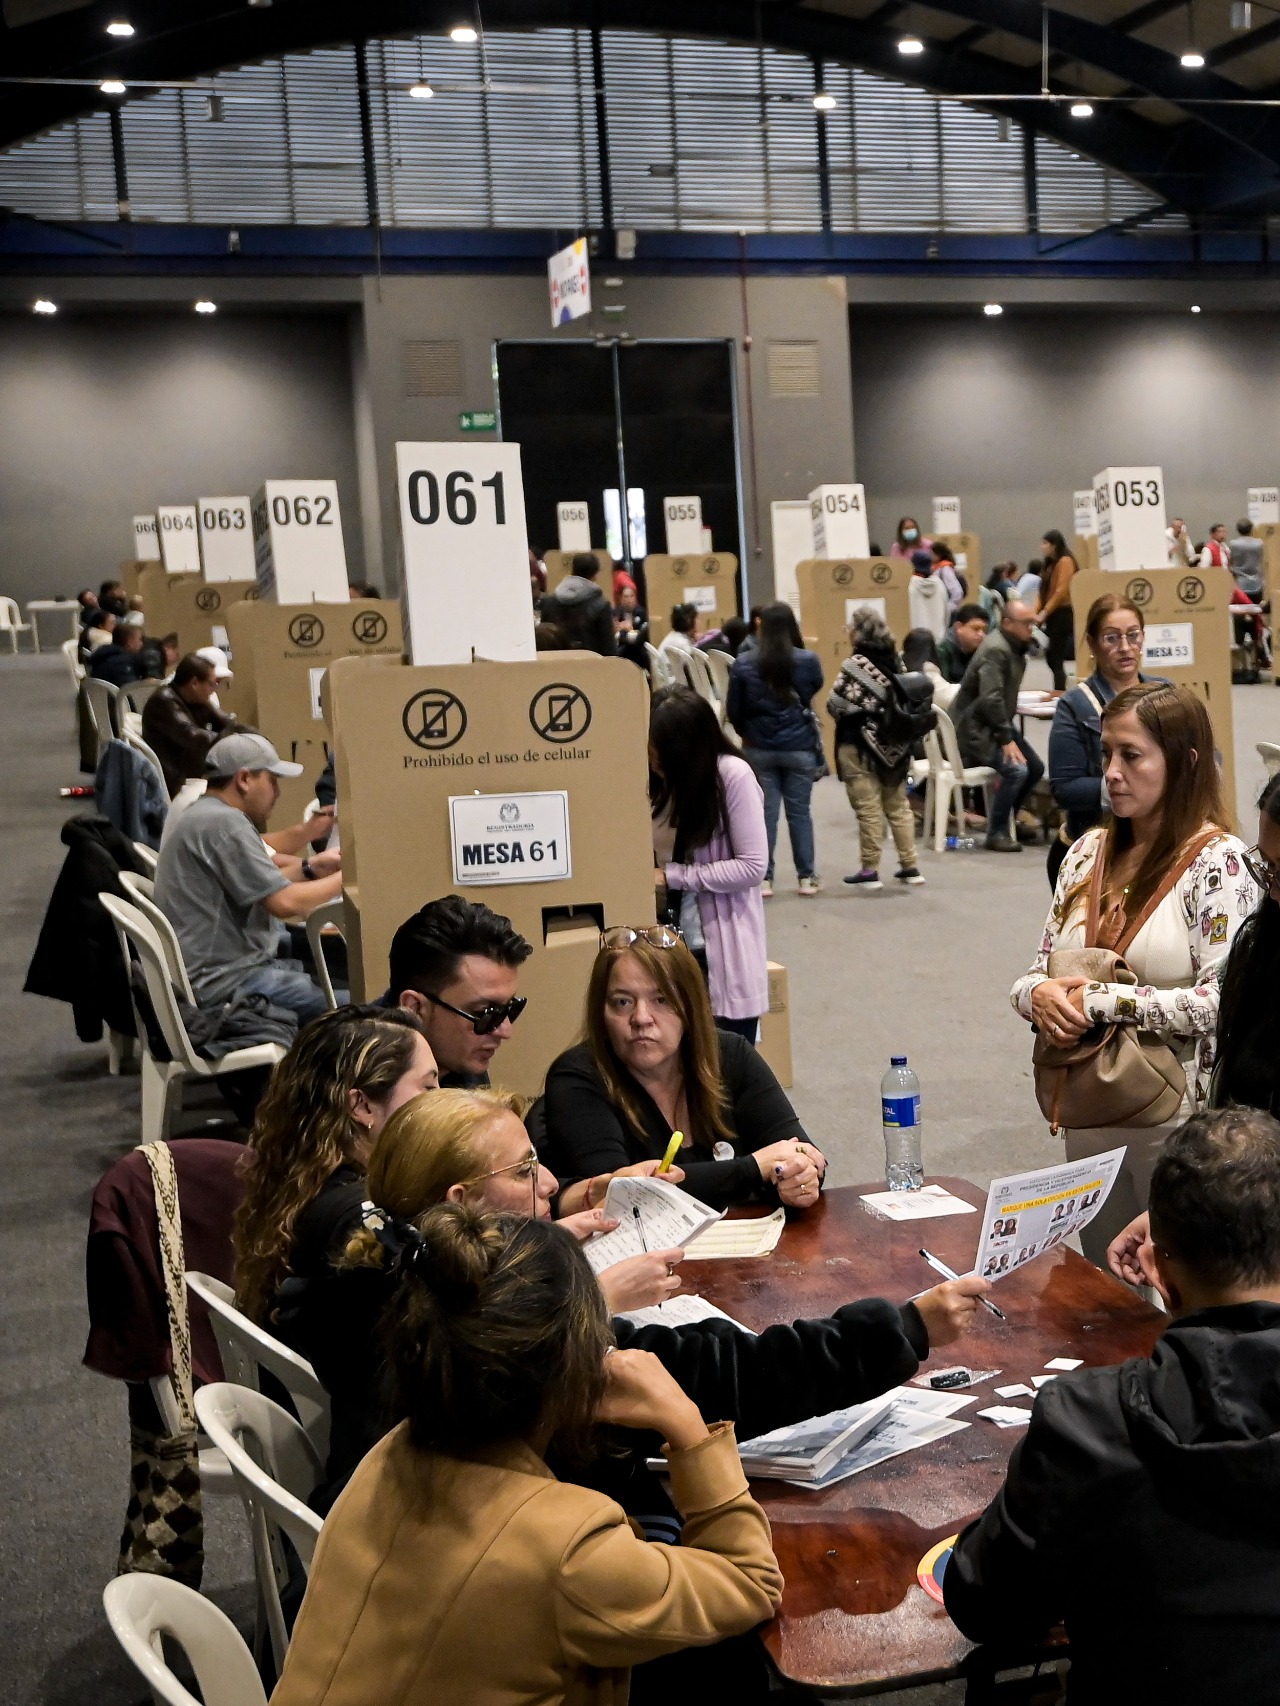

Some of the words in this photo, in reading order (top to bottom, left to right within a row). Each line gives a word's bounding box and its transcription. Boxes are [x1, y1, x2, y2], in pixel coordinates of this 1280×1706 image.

[408, 469, 506, 525] 061
[1114, 480, 1159, 506] 053
[272, 495, 334, 526] 062
[668, 504, 696, 521] 055
[825, 494, 861, 513] 054
[162, 513, 194, 531] 064
[203, 507, 246, 530] 063
[561, 507, 585, 521] 056
[1174, 645, 1188, 656] 53
[403, 751, 474, 769] Prohibido
[478, 751, 490, 764] el
[495, 753, 519, 764] uso
[523, 748, 540, 762] de
[544, 747, 591, 762] celular
[462, 841, 525, 866] MESA
[529, 839, 558, 861] 61
[1001, 1202, 1022, 1213] MARQUE
[1023, 1201, 1034, 1209] UNA
[1035, 1197, 1047, 1206] SOLA
